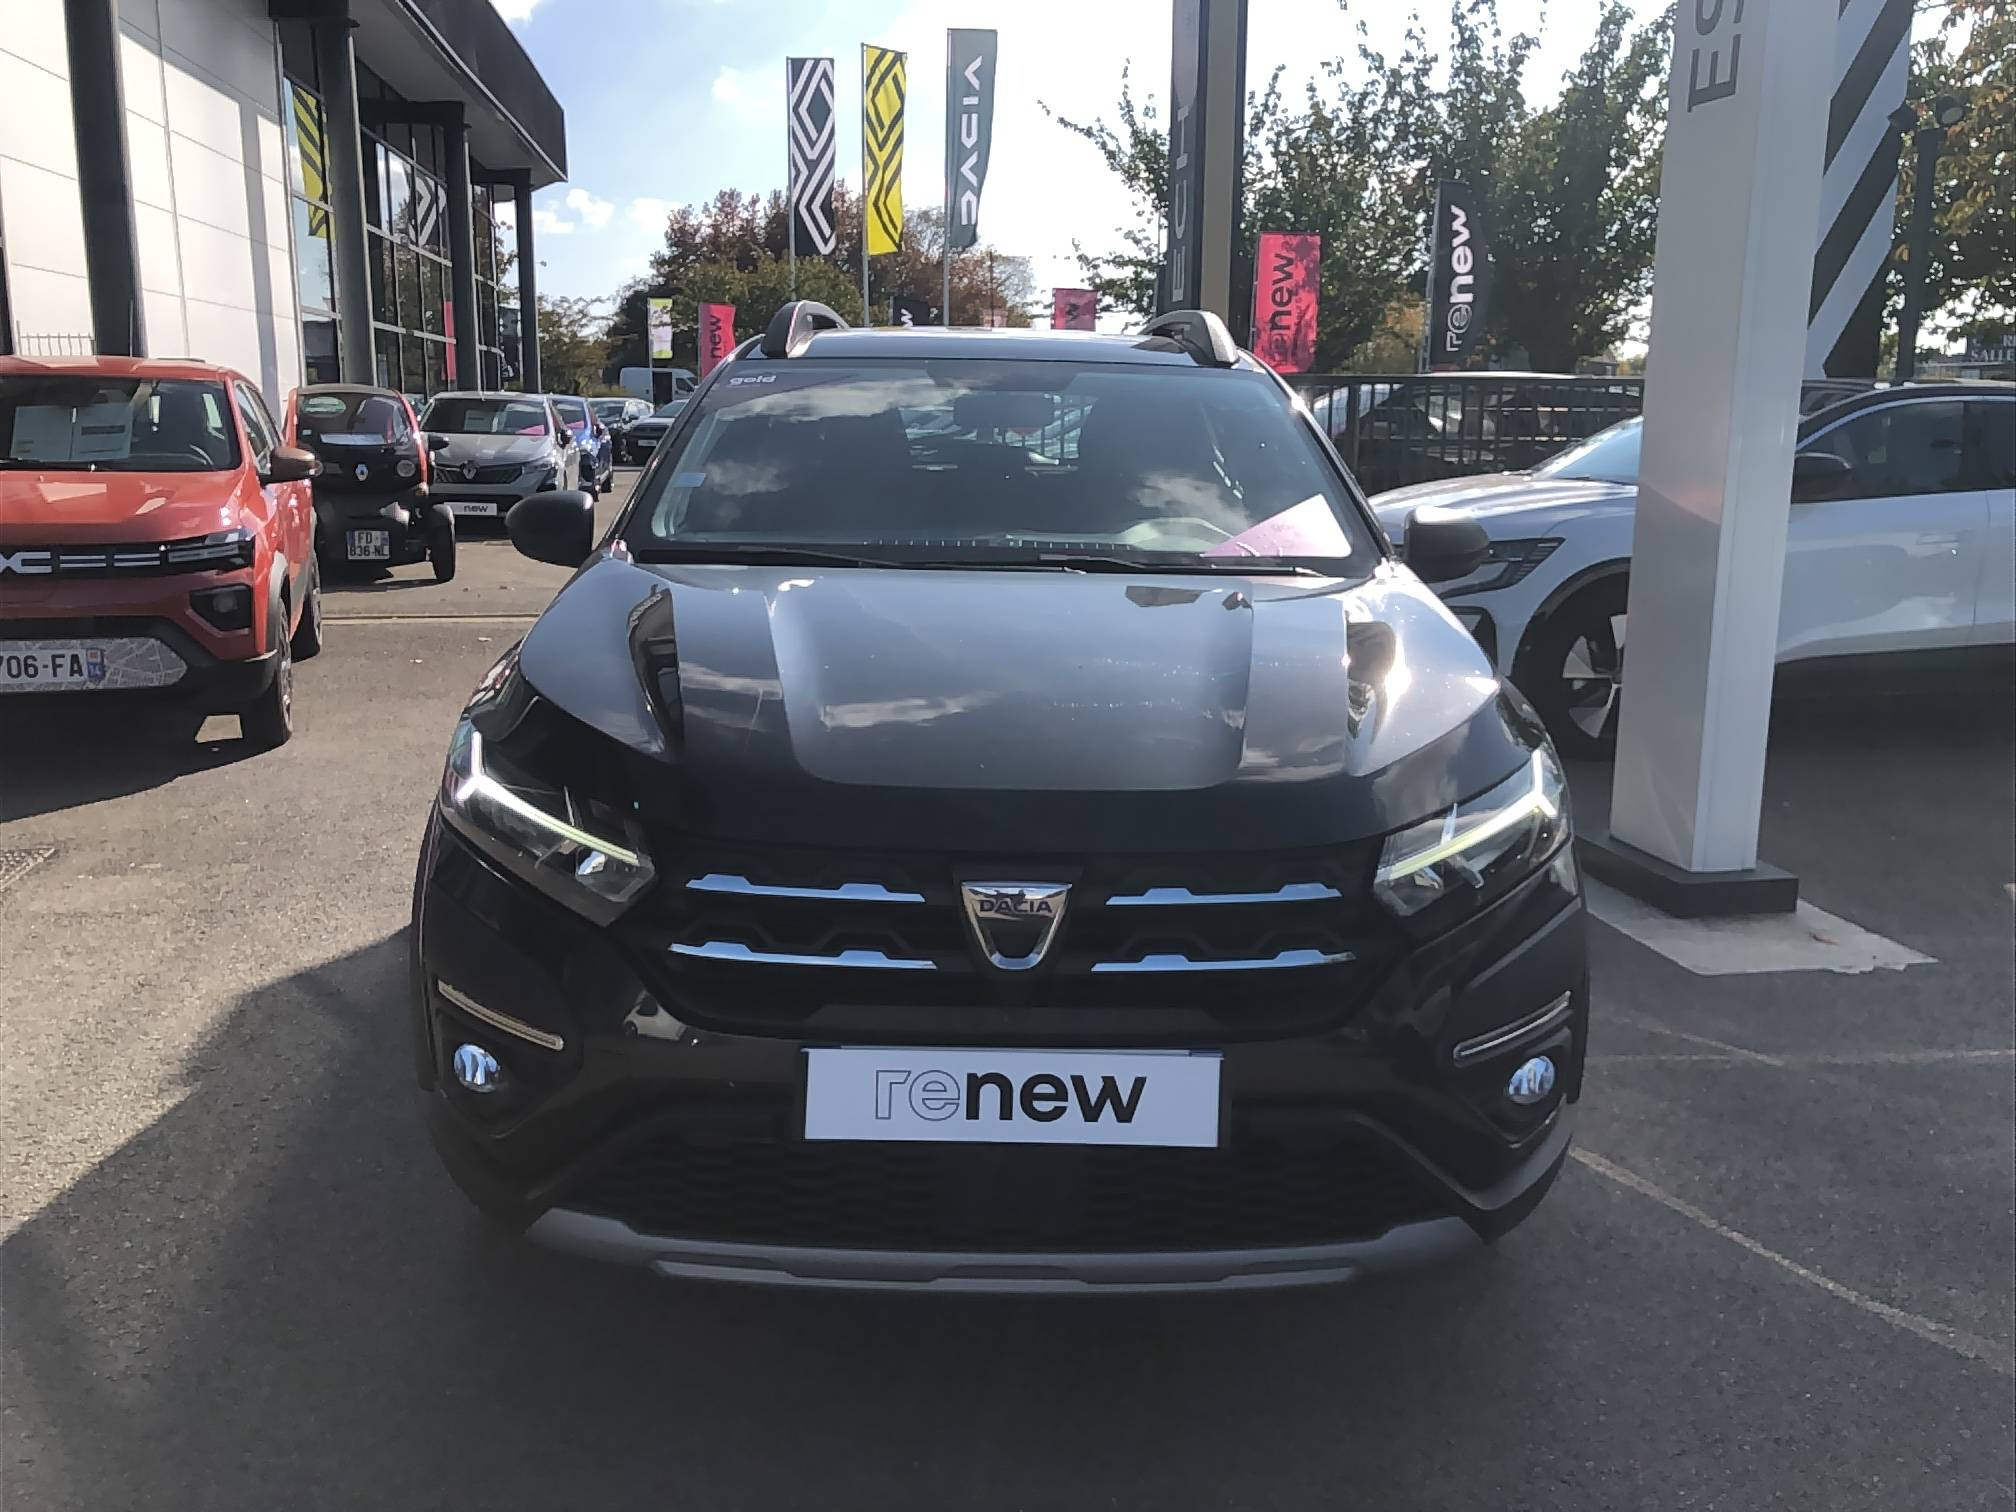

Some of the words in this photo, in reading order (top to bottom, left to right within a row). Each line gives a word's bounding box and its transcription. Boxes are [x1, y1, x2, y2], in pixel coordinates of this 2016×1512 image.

[960, 55, 983, 226] DACIA
[1446, 205, 1474, 351] renew
[730, 376, 776, 385] gold
[0, 654, 84, 679] 06-FA
[980, 900, 1053, 913] DACIA
[875, 1069, 1148, 1124] renew
